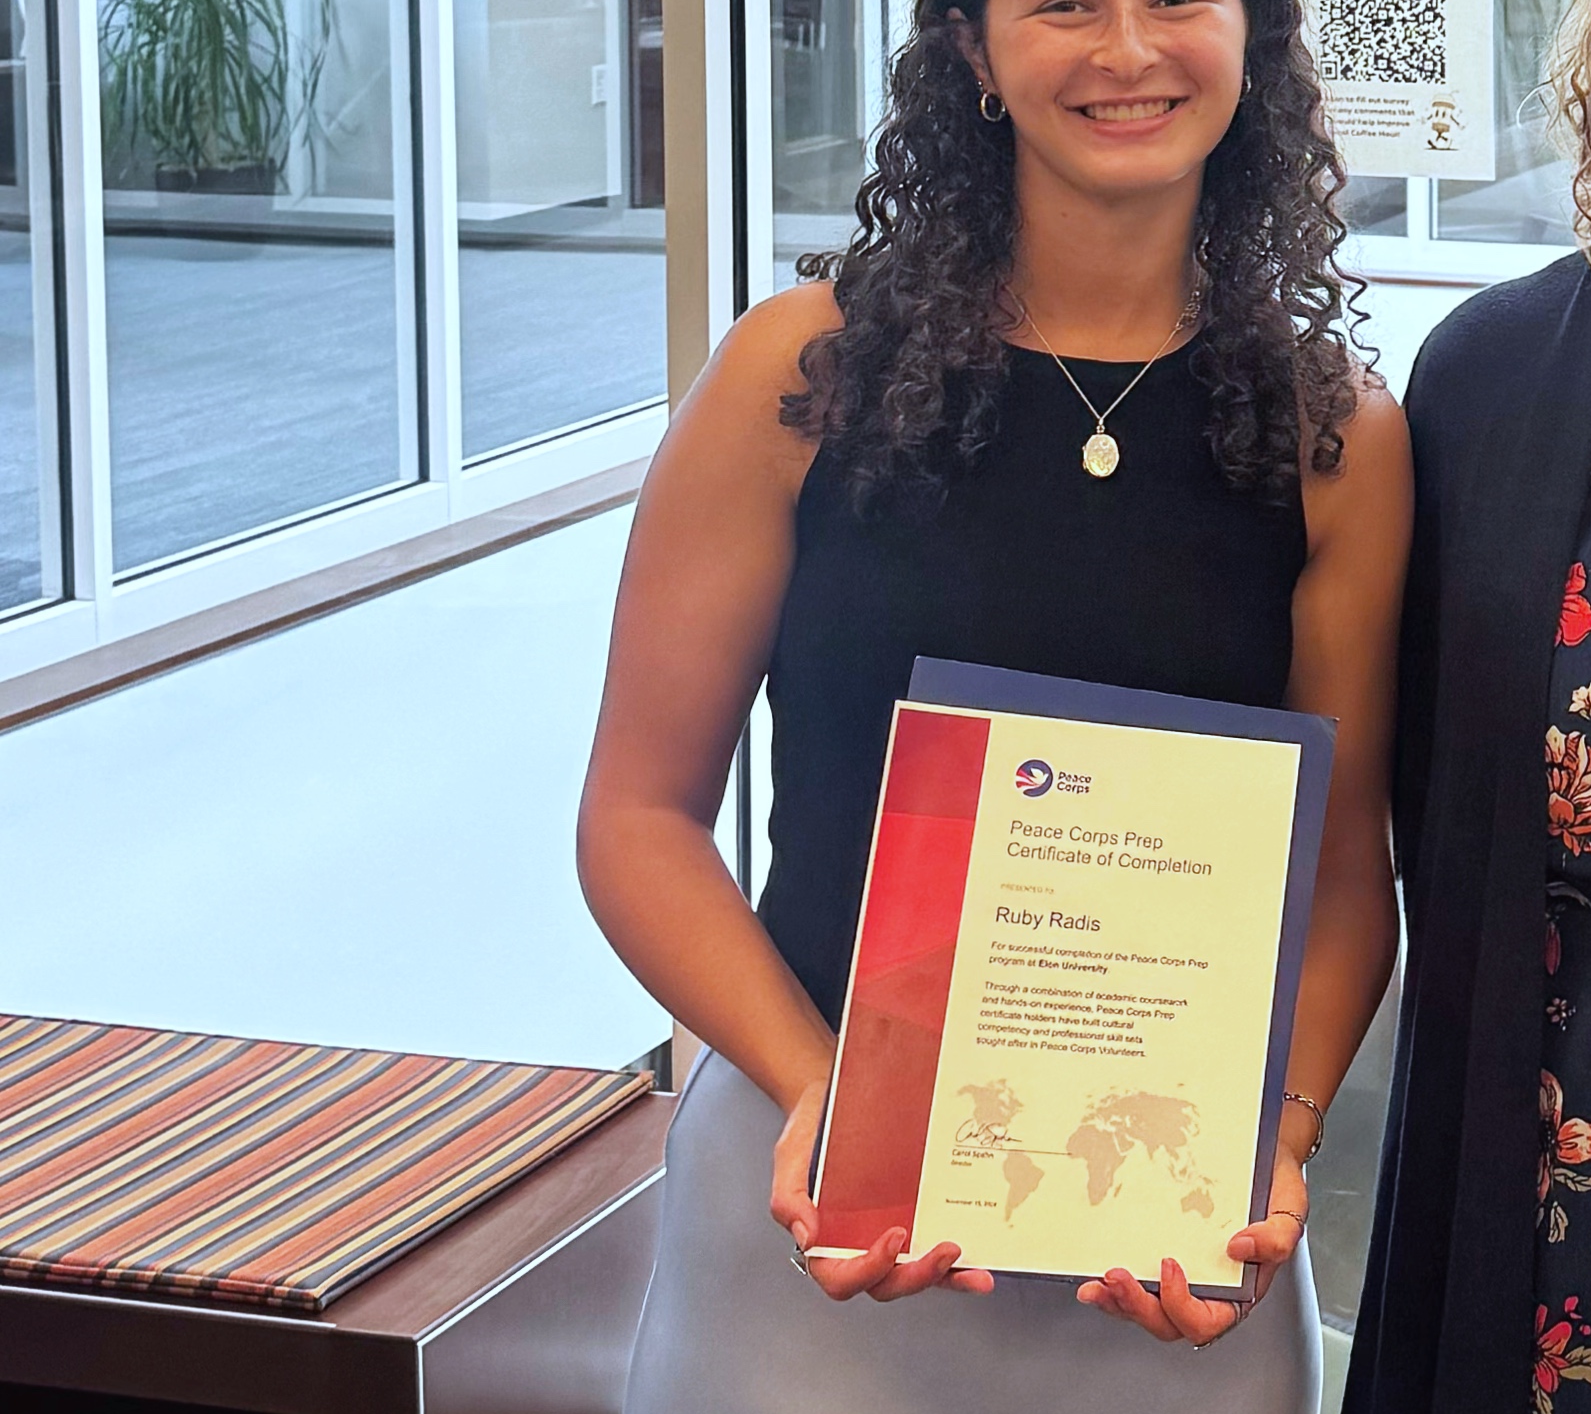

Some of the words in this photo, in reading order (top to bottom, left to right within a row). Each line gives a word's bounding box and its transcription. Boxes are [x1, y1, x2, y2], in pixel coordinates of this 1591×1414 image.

[1056, 780, 1090, 794] Corps
[1057, 770, 1092, 784] Peace
[1009, 819, 1064, 840] Peace
[1068, 825, 1119, 848] Corps
[1123, 831, 1163, 852] Prep
[1006, 841, 1092, 864] Certificate
[1096, 850, 1114, 867] of
[1117, 852, 1212, 878] Completion
[994, 905, 1044, 930] Ruby
[1048, 910, 1101, 932] Radis
